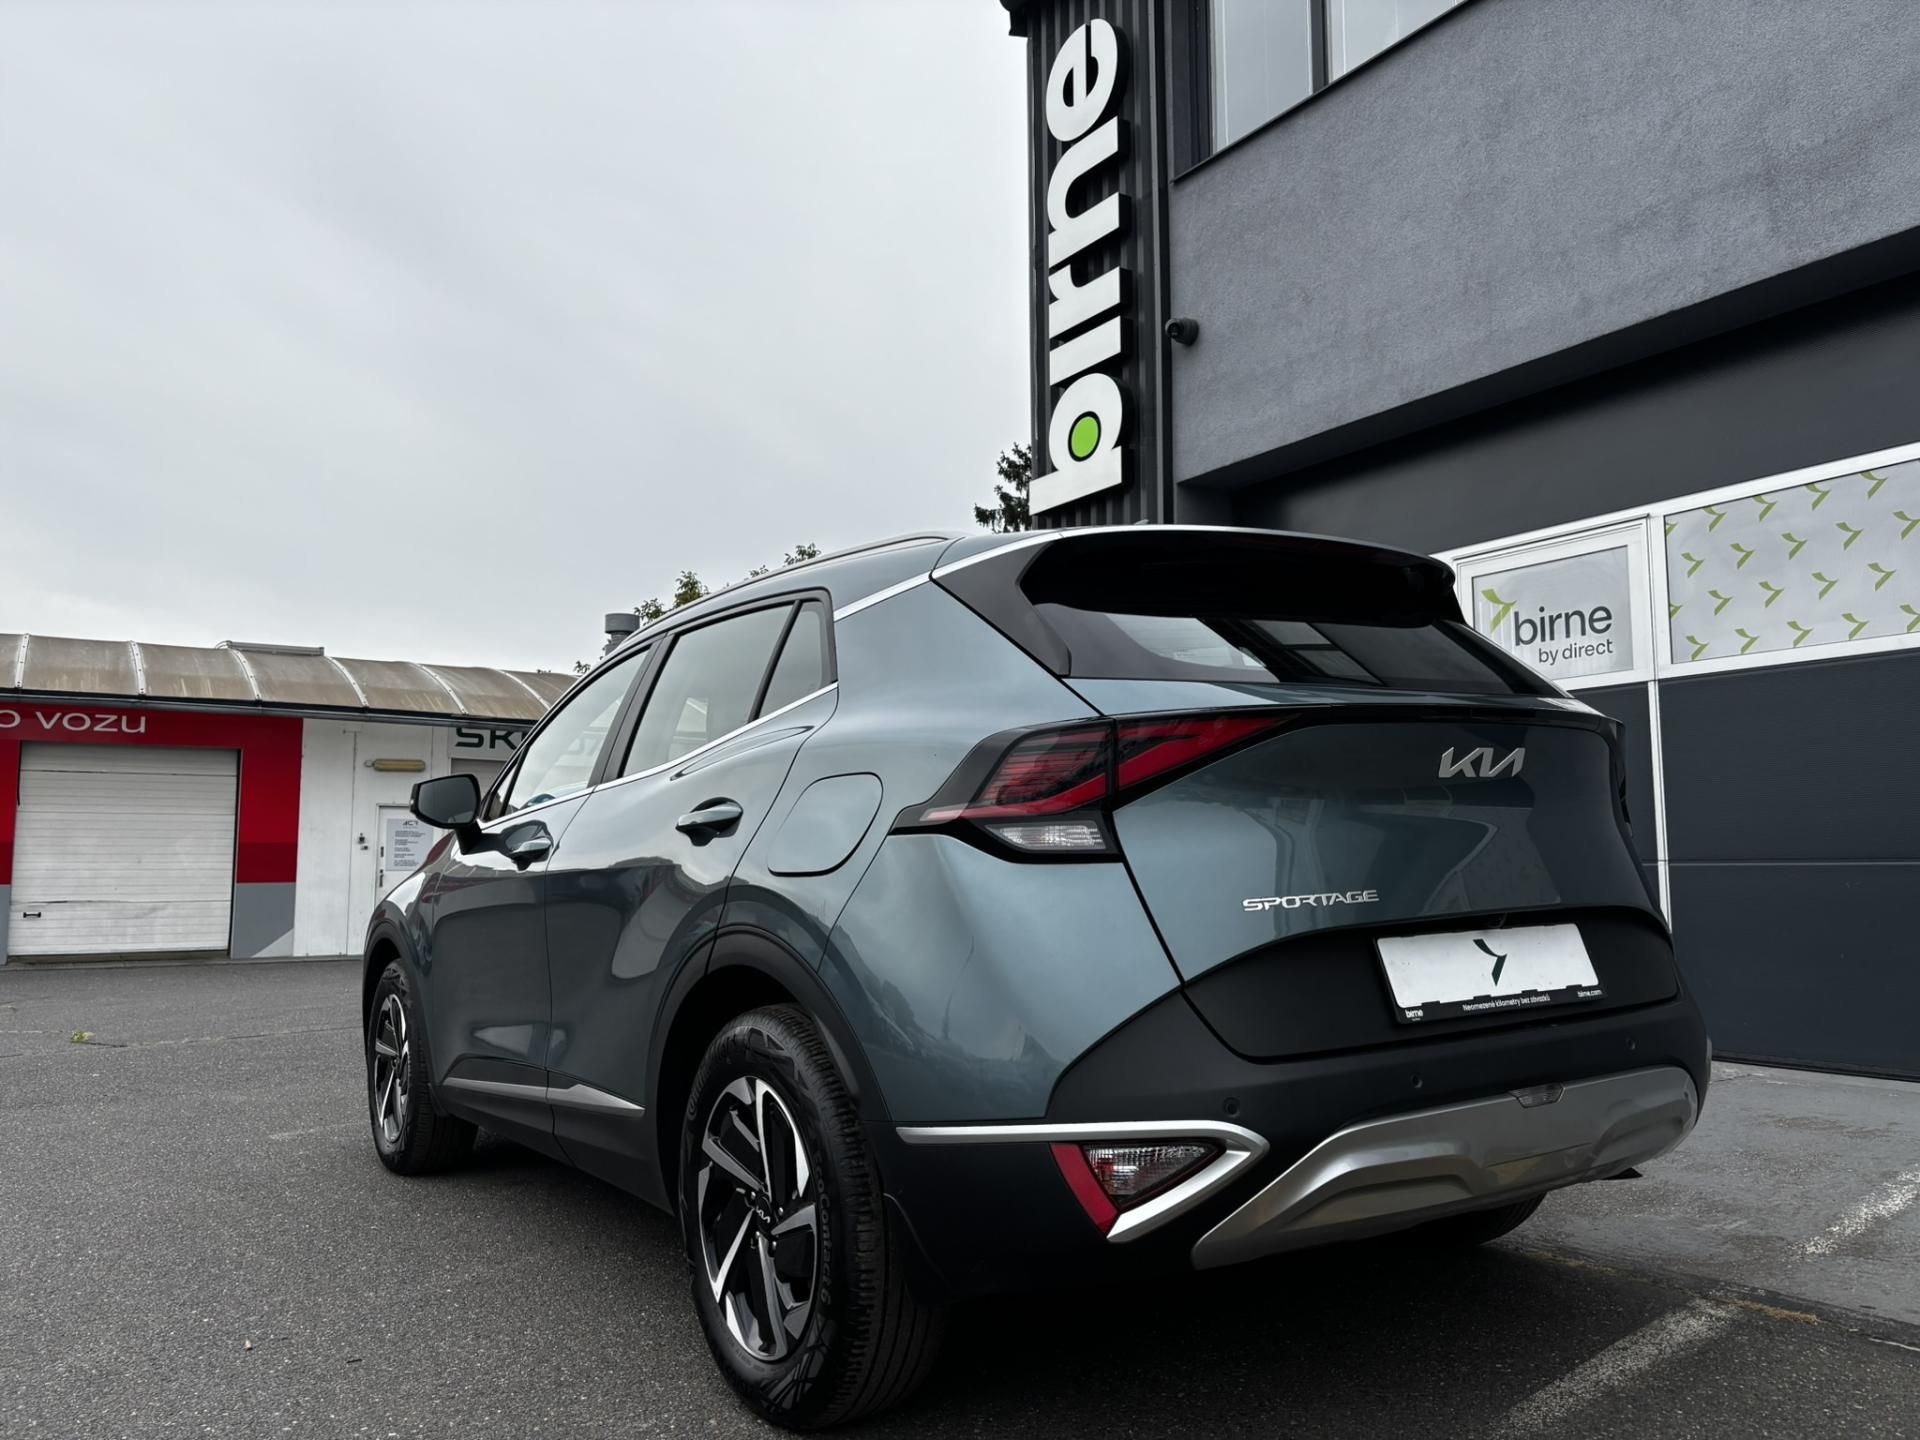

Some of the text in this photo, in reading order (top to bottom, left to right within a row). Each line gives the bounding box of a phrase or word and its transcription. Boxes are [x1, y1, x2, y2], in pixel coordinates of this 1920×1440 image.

[1029, 18, 1123, 516] birne
[1514, 605, 1613, 646] birne
[1538, 639, 1614, 666] by direct
[35, 711, 147, 734] vozu
[1438, 747, 1526, 778] KIA
[1242, 889, 1380, 912] SPORTAGE
